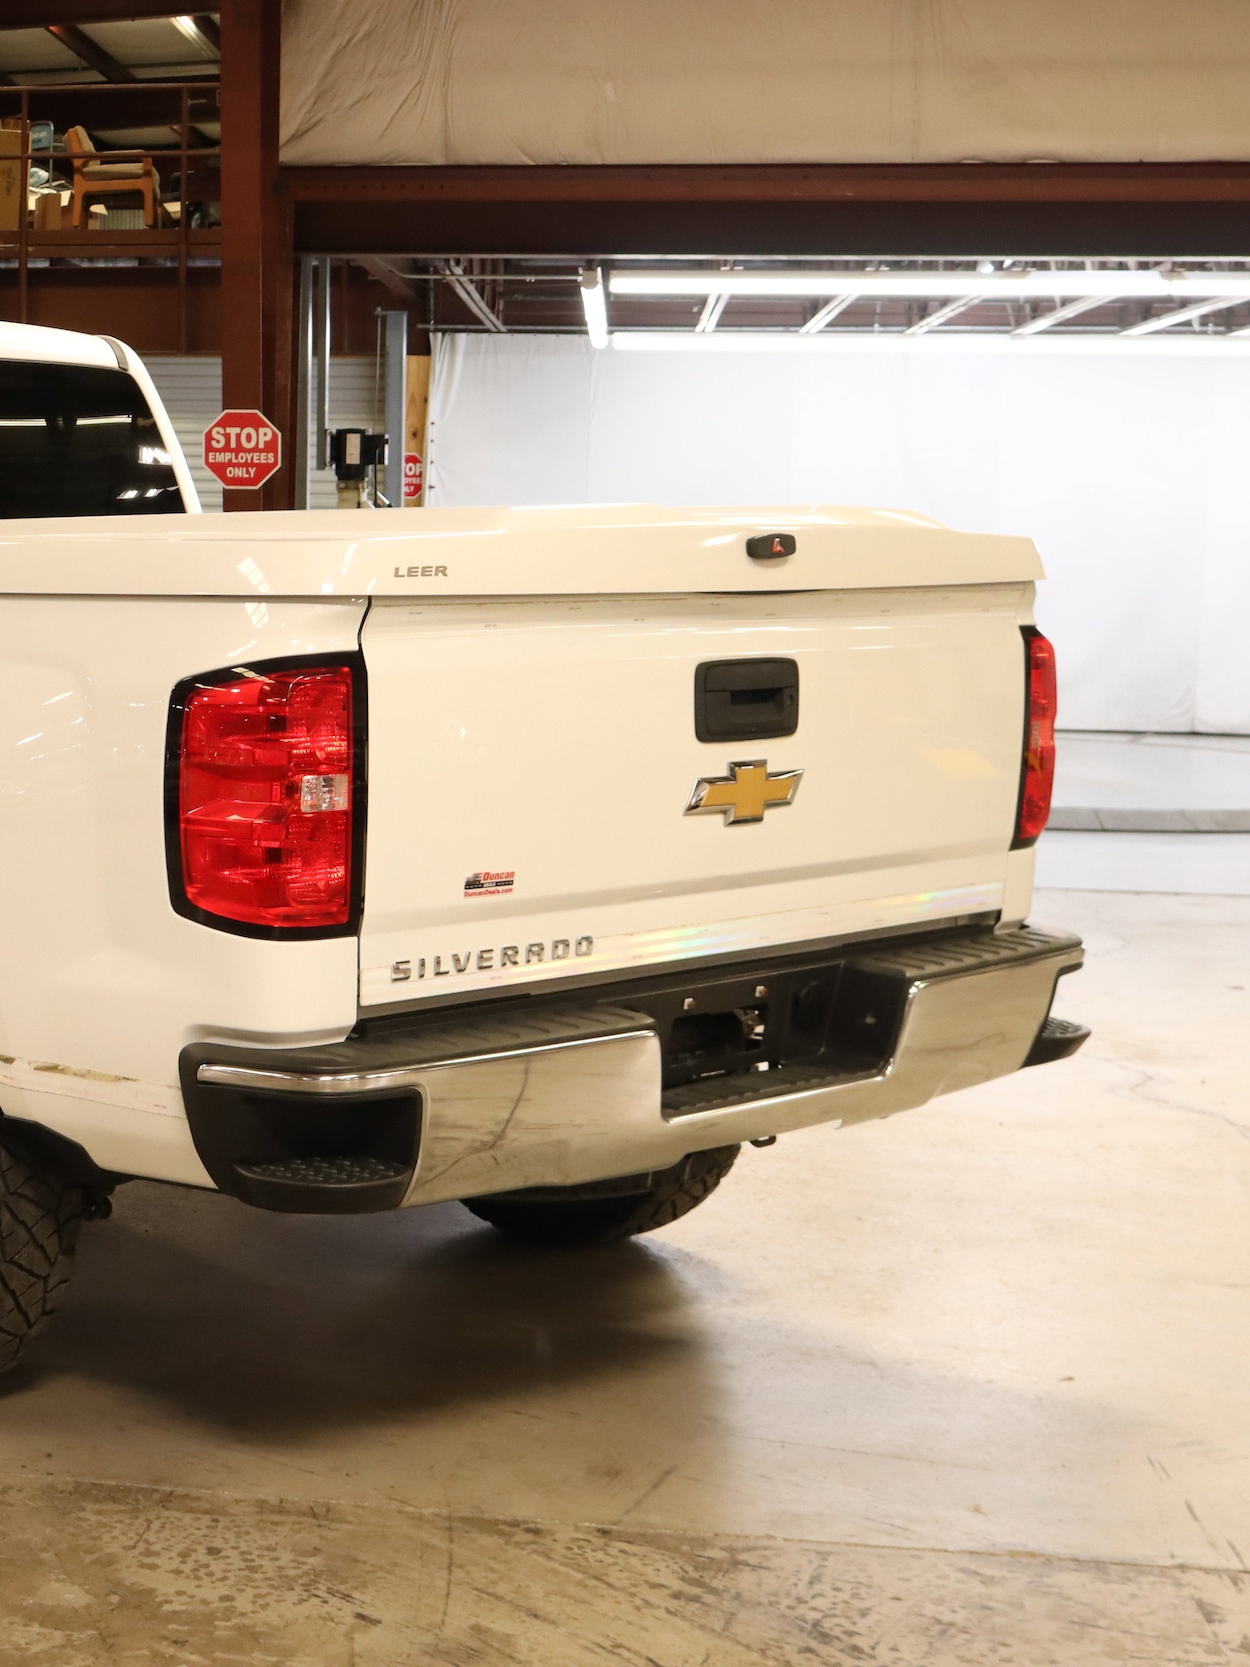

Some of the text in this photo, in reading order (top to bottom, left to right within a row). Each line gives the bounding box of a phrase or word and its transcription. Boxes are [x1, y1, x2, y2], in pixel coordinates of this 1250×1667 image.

[210, 426, 273, 449] STOP
[208, 452, 275, 464] EMPLOYEES
[226, 467, 256, 479] ONLY
[404, 462, 423, 476] OP
[394, 565, 448, 578] LEER
[482, 871, 515, 881] Duncan
[391, 935, 594, 982] SILVERADO
